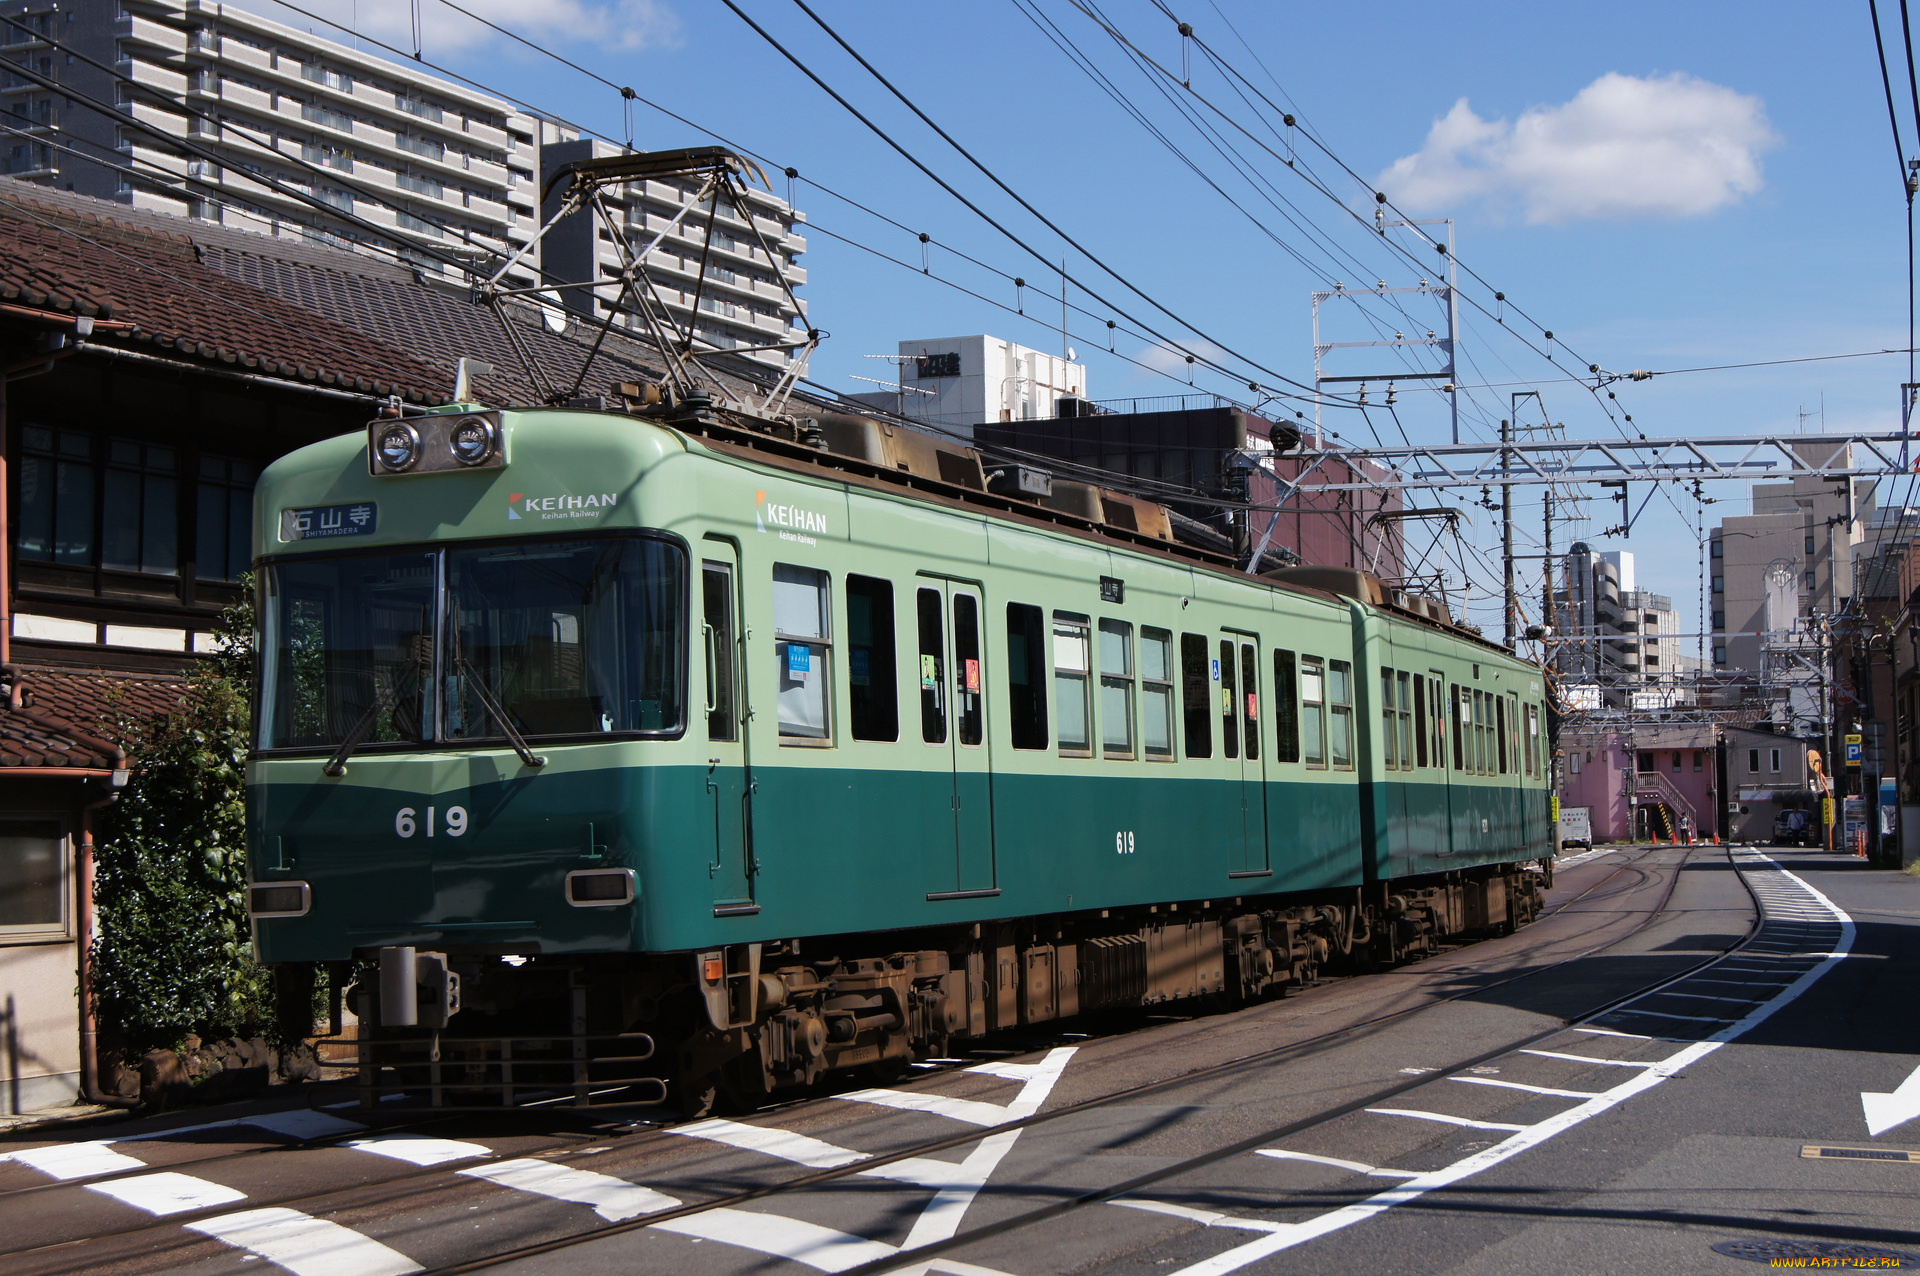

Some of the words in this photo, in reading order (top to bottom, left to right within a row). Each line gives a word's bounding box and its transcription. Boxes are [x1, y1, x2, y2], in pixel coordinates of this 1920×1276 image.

[292, 506, 371, 531] 石山寺
[541, 512, 568, 520] Keihan
[570, 510, 600, 518] Railway
[1848, 746, 1859, 759] P
[395, 805, 468, 838] 619
[1116, 831, 1135, 854] 619
